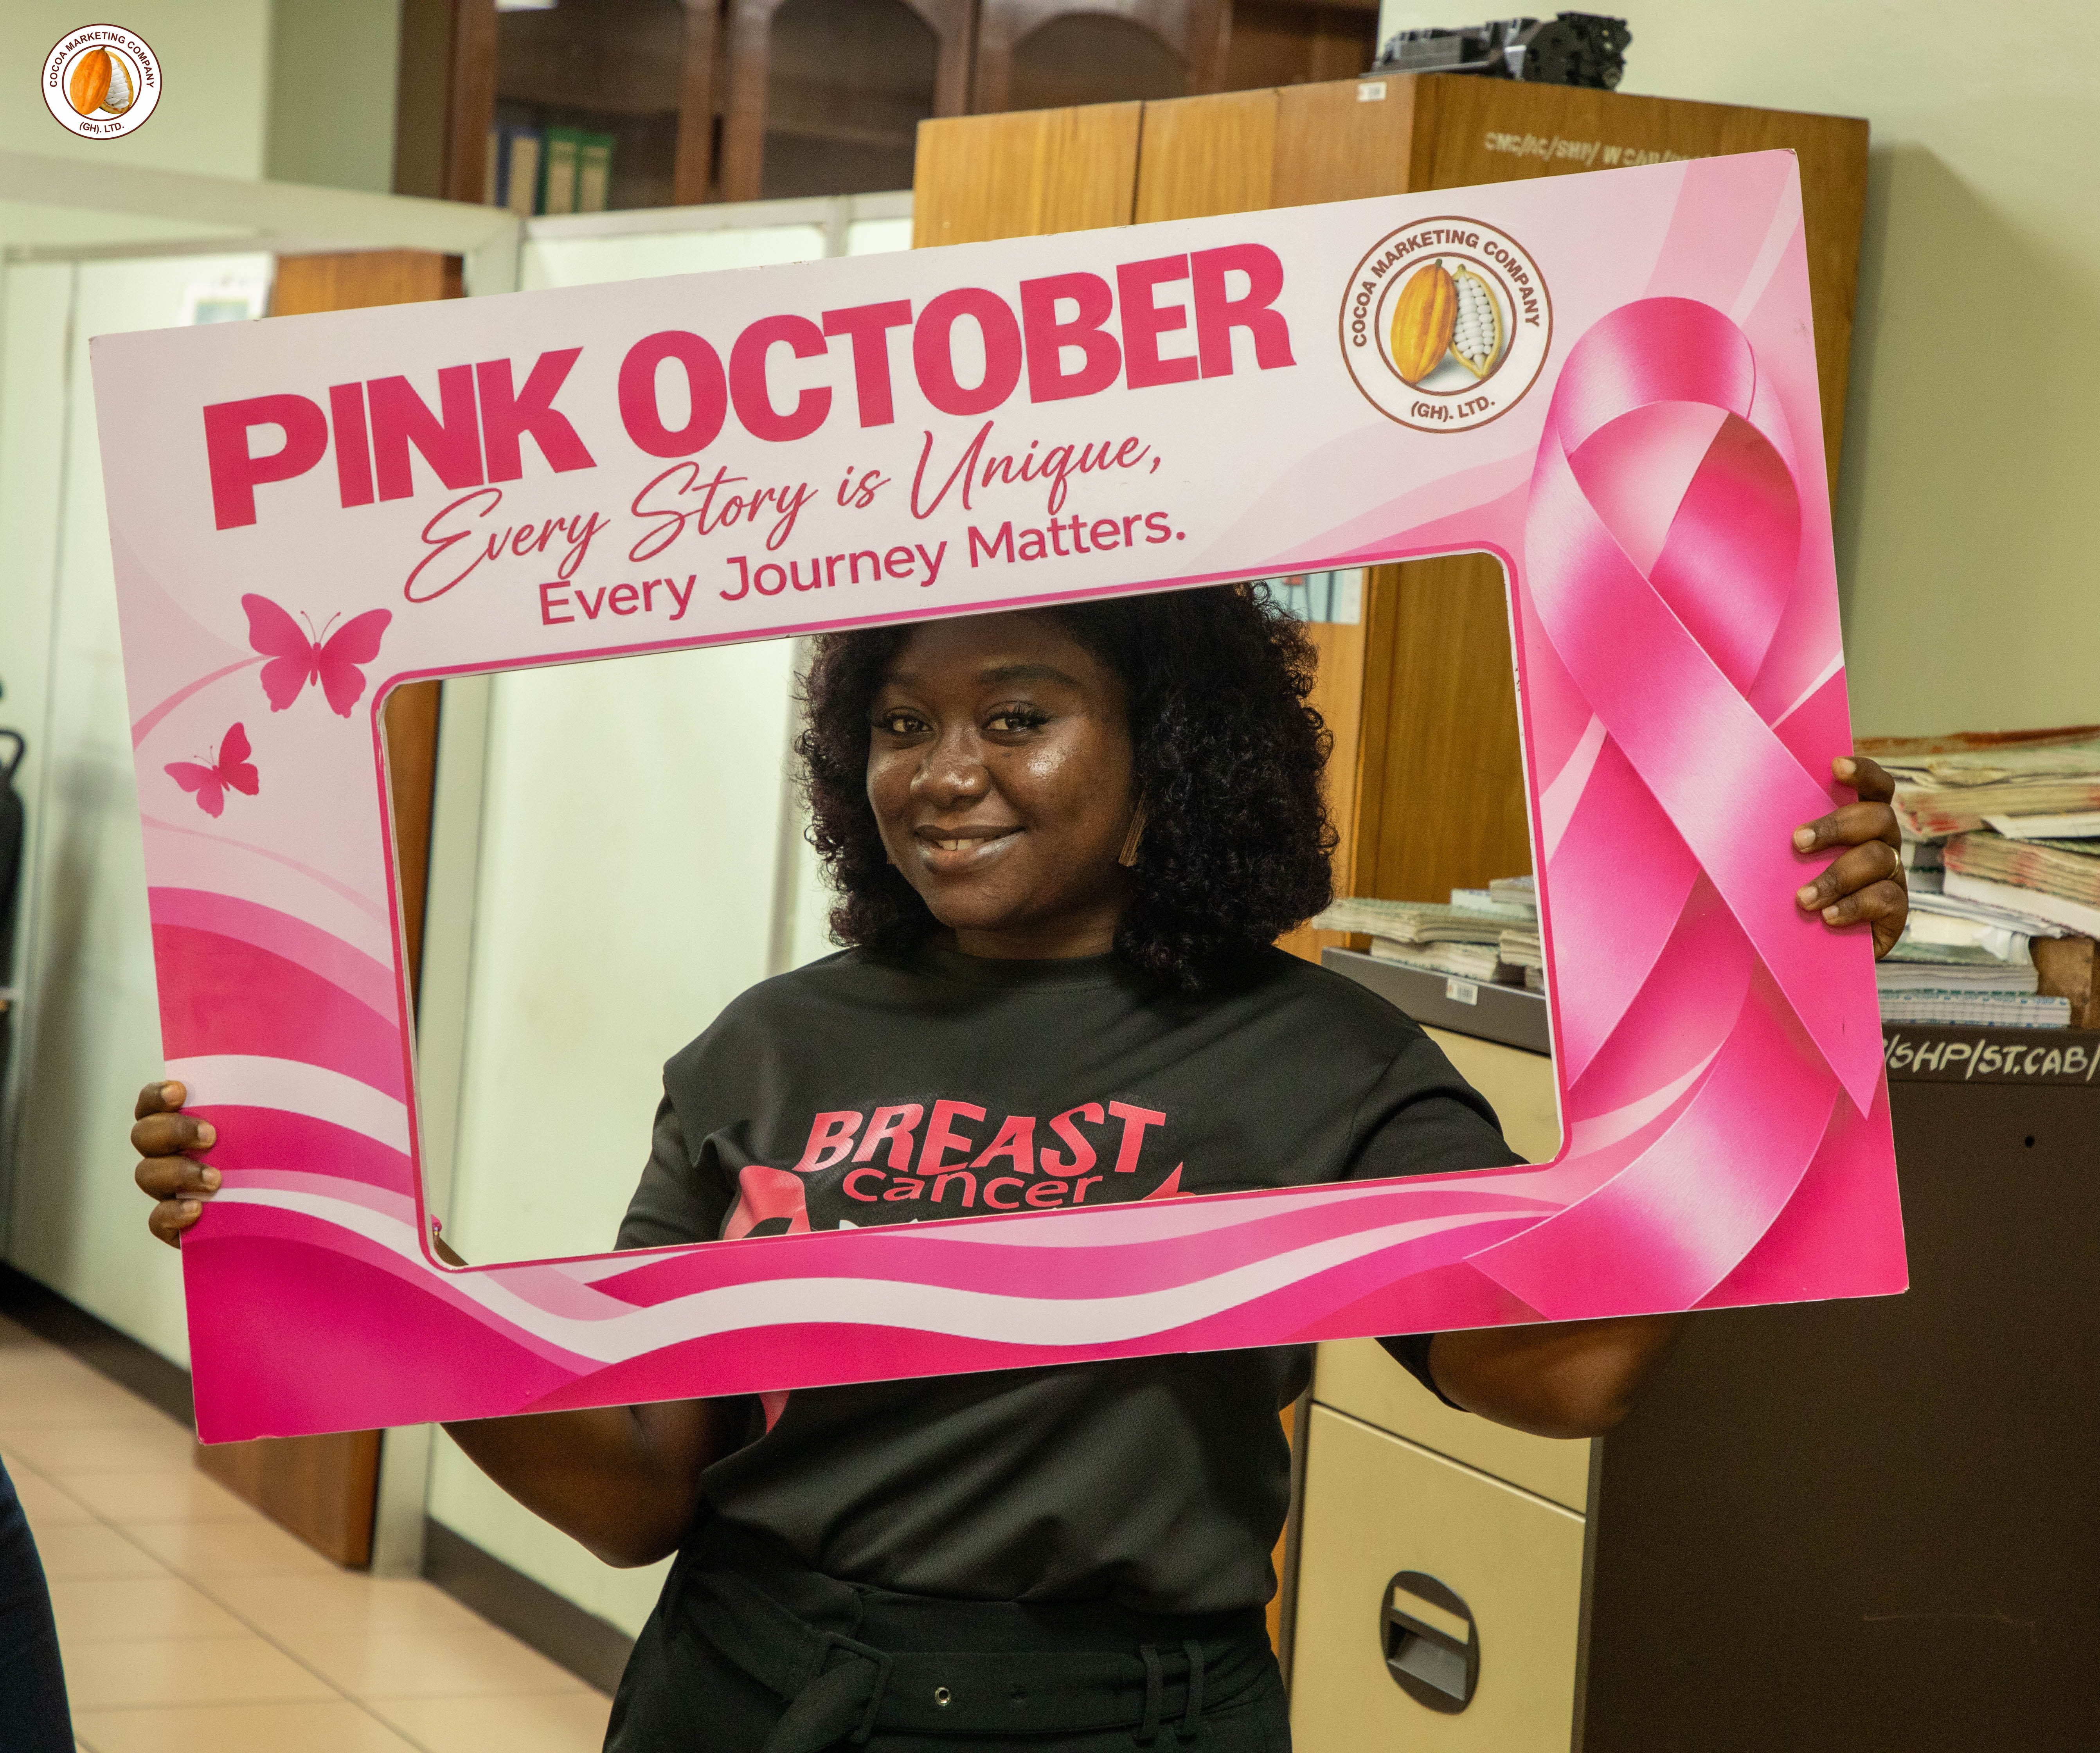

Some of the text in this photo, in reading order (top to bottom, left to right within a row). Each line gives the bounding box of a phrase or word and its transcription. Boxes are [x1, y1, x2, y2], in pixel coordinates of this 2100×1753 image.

[1351, 229, 1540, 347] COCOA MARKETING COMPANY
[203, 243, 1297, 531] PINK OCTOBER
[1411, 396, 1495, 422] (GH). LTD.
[404, 420, 1162, 603] Every Story is Unique,
[539, 511, 1186, 625] Every Journey Matters.
[1883, 1033, 2100, 1082] /SHP/ST.CAB/
[792, 1099, 1166, 1176] BREAST
